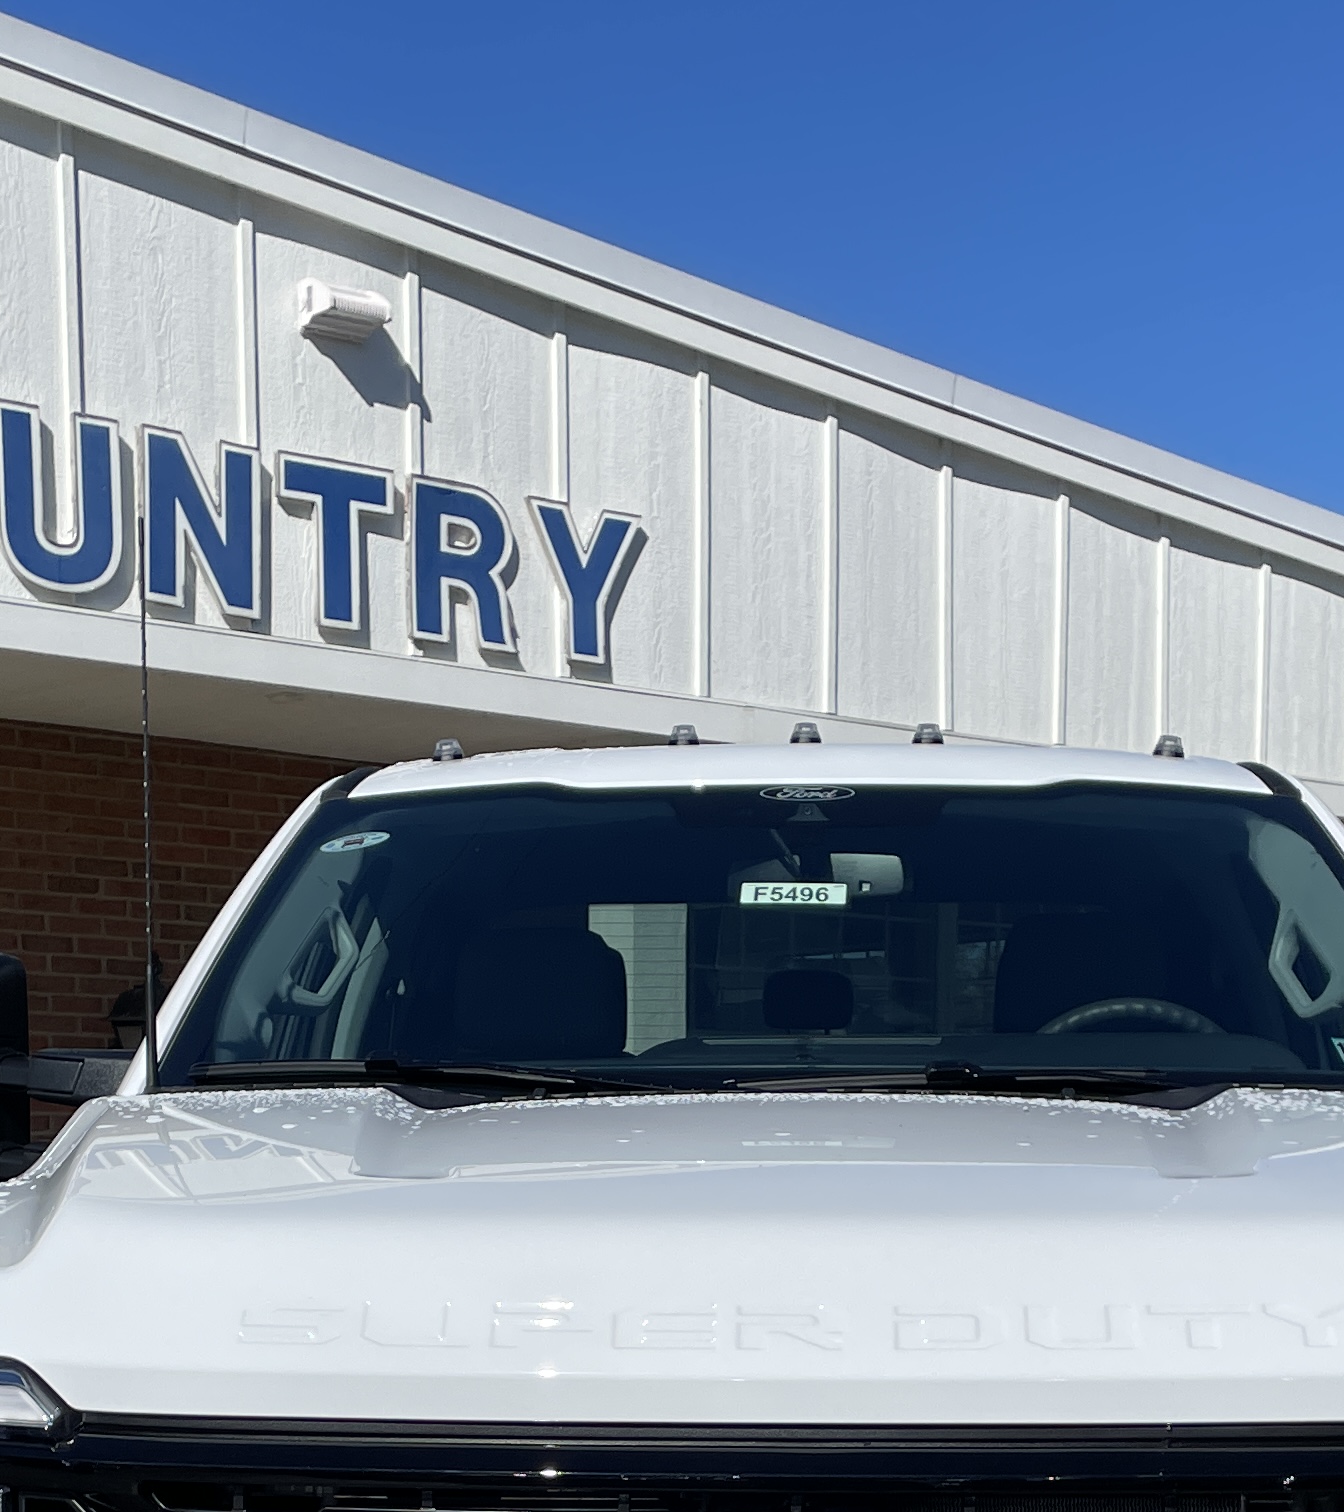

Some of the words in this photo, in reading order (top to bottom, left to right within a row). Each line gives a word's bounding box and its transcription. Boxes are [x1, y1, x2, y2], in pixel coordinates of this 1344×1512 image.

[776, 786, 838, 799] Ford
[753, 886, 829, 902] F5496
[236, 1297, 844, 1351] SUPER
